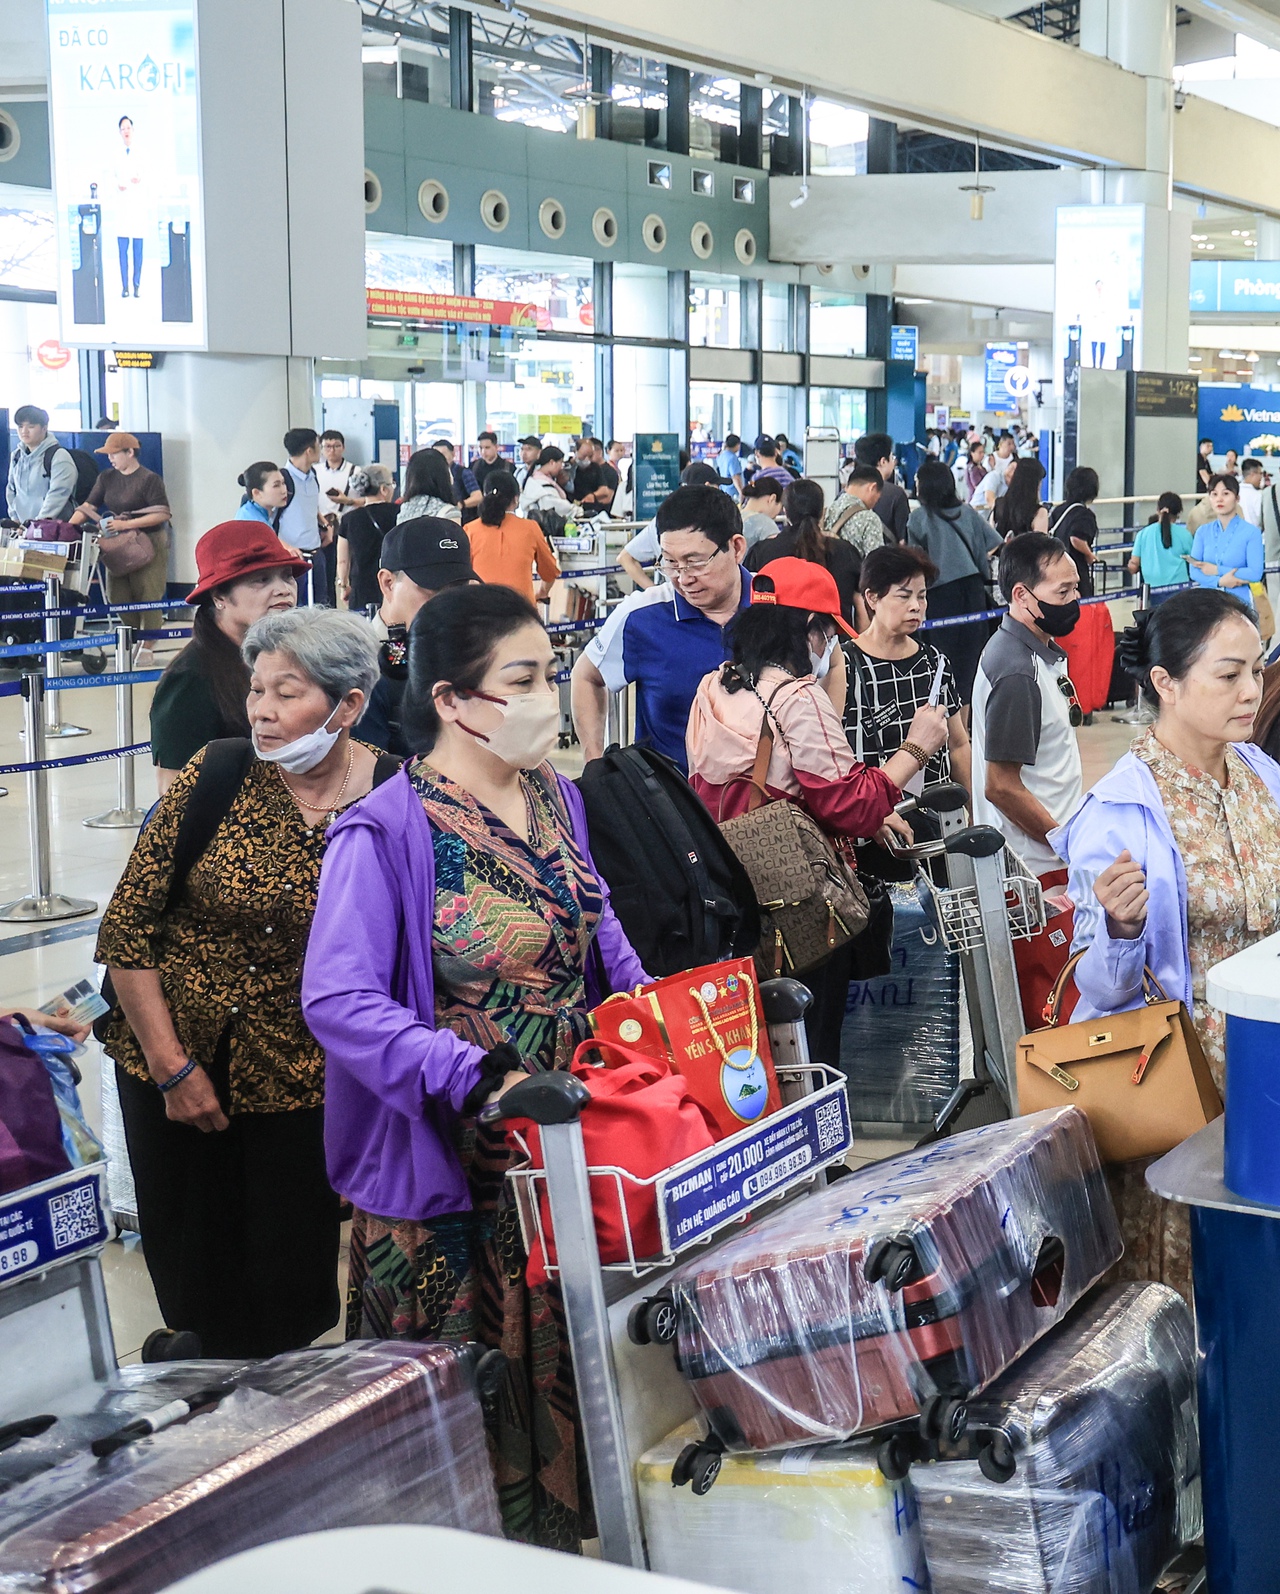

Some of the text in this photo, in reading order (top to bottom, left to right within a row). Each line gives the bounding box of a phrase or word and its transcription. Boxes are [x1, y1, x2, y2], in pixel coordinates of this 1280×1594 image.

[59, 25, 108, 46] ĐÃ CÓ
[80, 53, 181, 91] KAROFI
[47, 678, 76, 688] KHÔNG
[735, 827, 760, 841] CLN
[758, 836, 783, 849] CLN
[741, 850, 765, 863] CLN
[764, 857, 788, 871] CLN
[784, 864, 808, 878] CLN
[769, 880, 793, 895] CLN
[685, 1039, 706, 1060] YẾN
[728, 1140, 764, 1179] 20.000
[672, 1167, 713, 1202] BIZMAN
[676, 1189, 741, 1236] LIÊN HỆ QUẢNG CÁO
